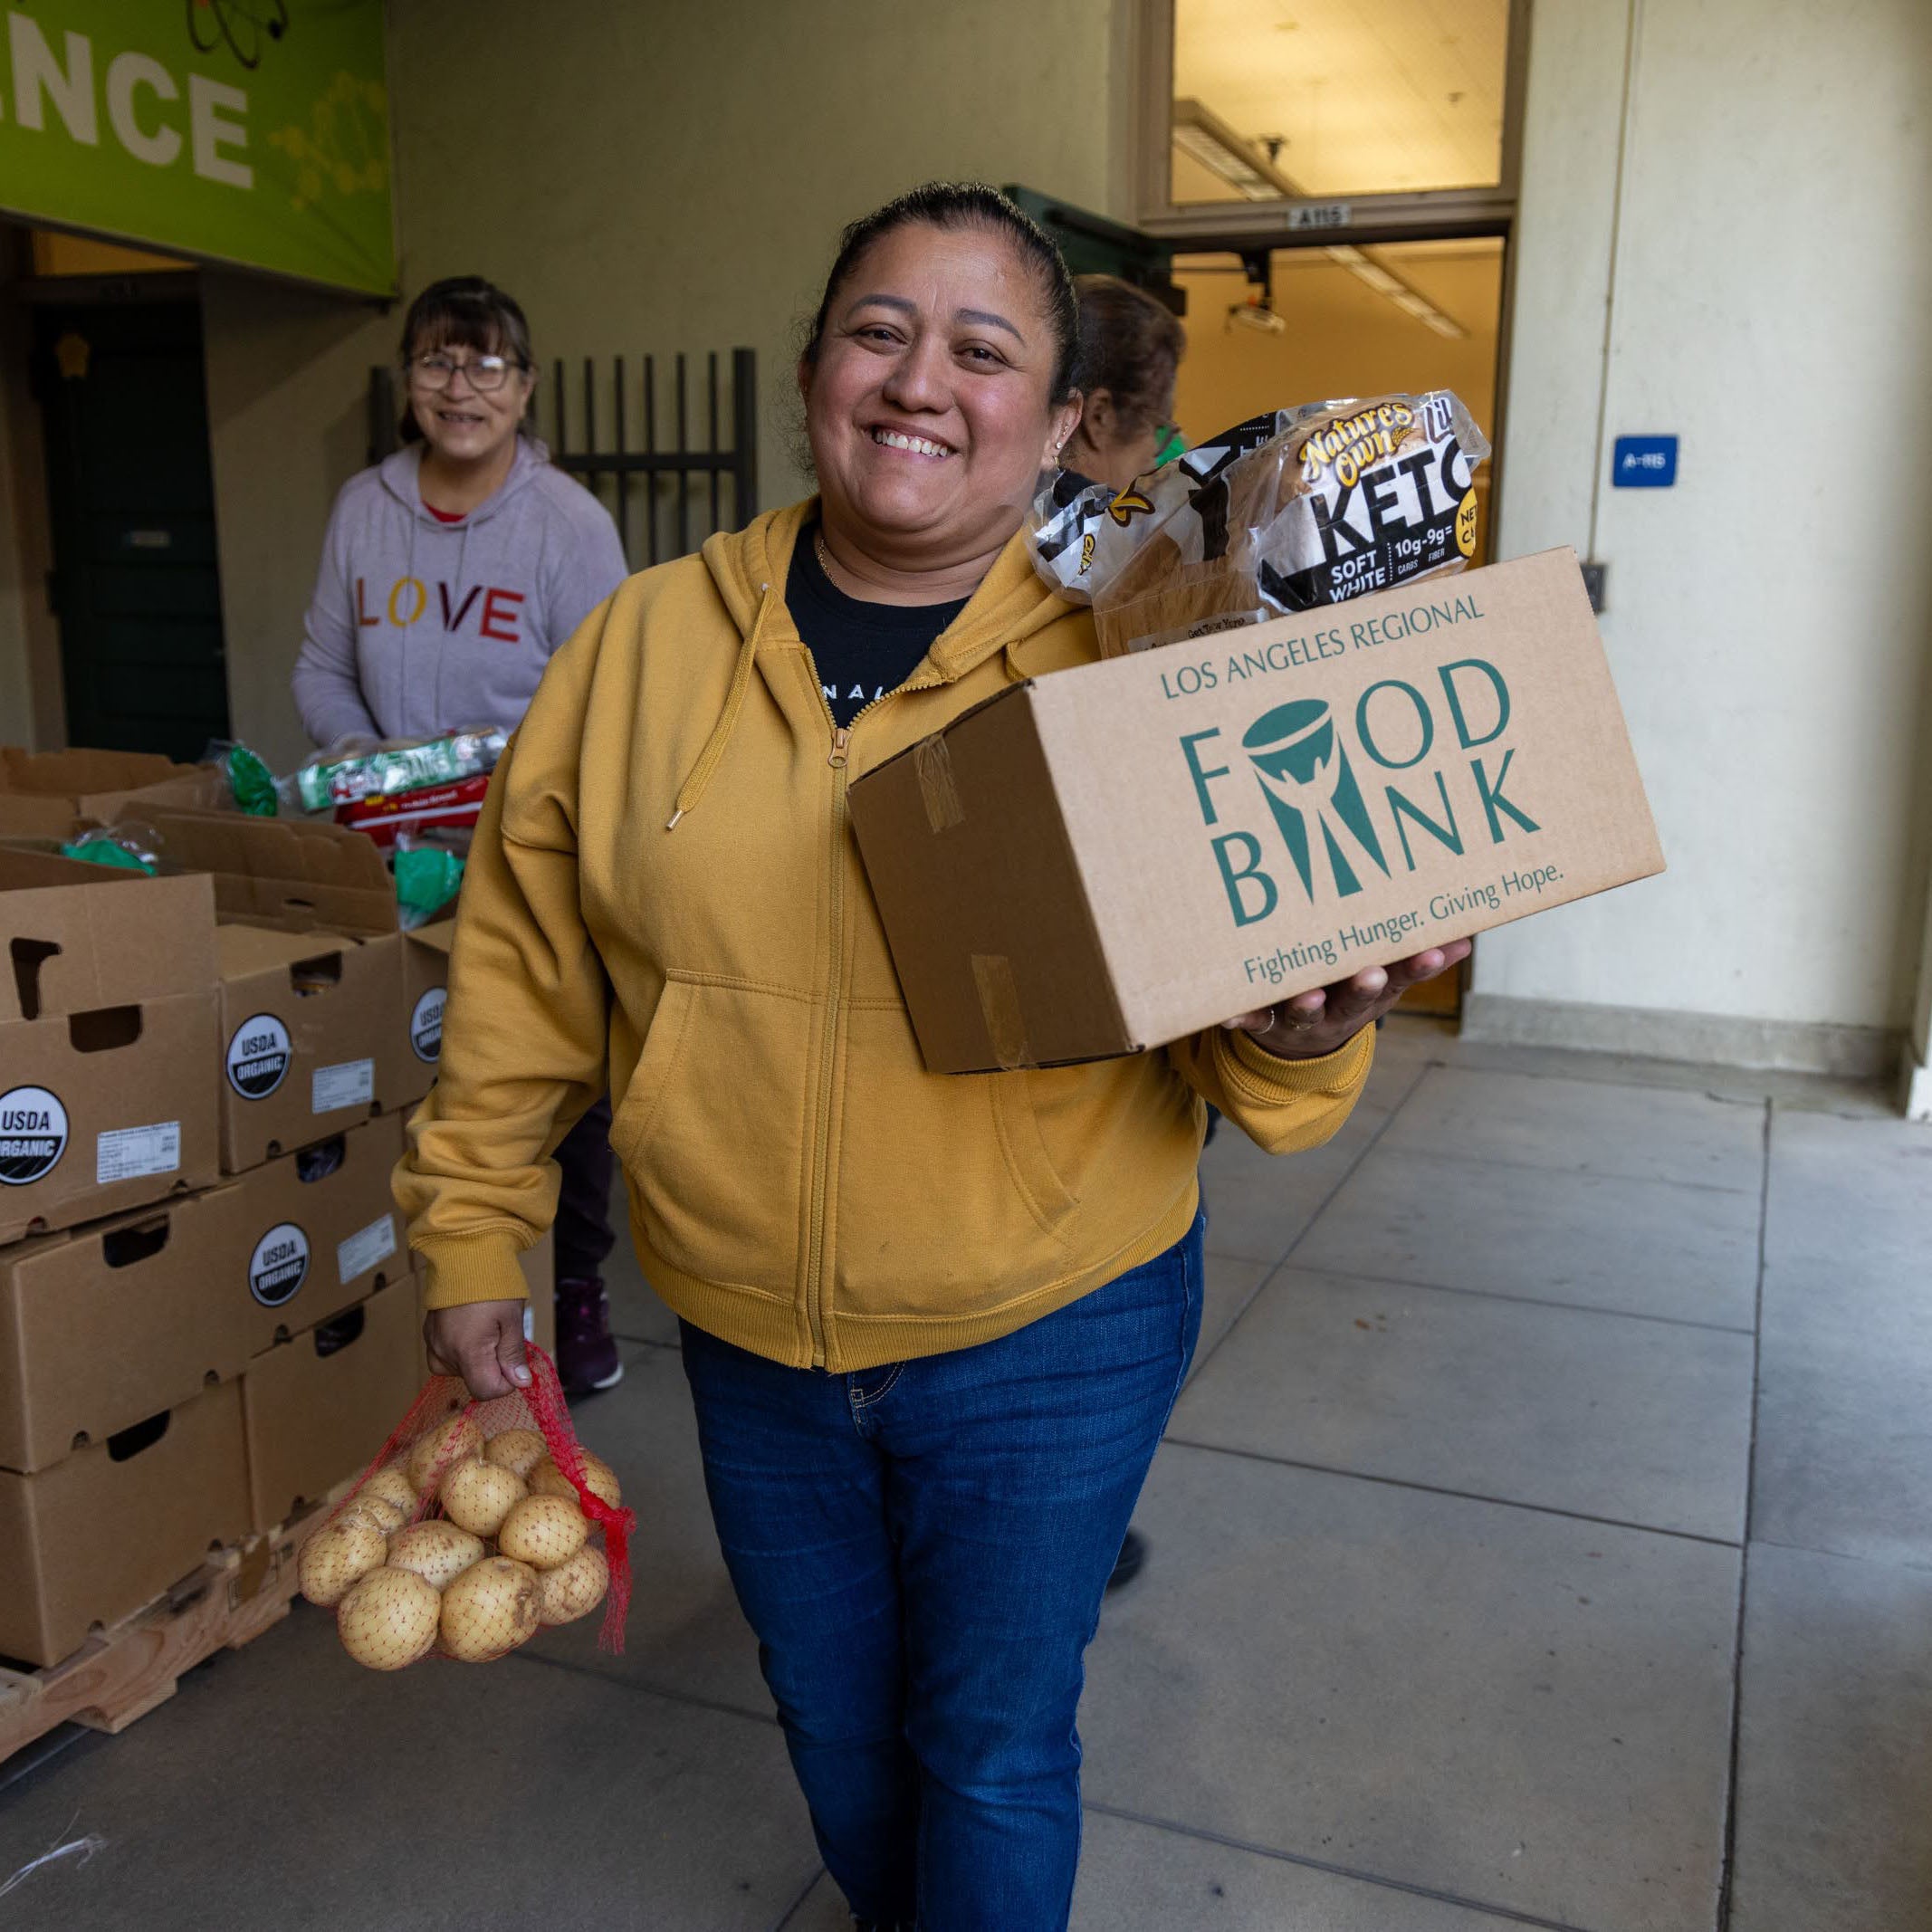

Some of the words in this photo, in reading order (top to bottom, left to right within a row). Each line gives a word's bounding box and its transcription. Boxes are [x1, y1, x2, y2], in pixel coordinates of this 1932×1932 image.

[0, 9, 254, 190] NCE
[1297, 402, 1413, 481] Nature's
[1334, 427, 1398, 488] Own
[1330, 550, 1377, 585] SOFT
[1397, 560, 1419, 575] CARBS
[1428, 548, 1446, 562] FIBER
[1328, 567, 1386, 603] WHITE
[357, 576, 525, 643] LOVE
[1160, 661, 1218, 700] LOS
[1227, 628, 1346, 683] ANGELES
[1350, 594, 1486, 650] REGIONAL
[1243, 938, 1338, 985] Fighting
[1339, 908, 1425, 952] Hunger.
[1429, 881, 1500, 921] Giving
[1501, 863, 1564, 896] Hope.
[241, 1032, 277, 1057] USDA
[236, 1056, 284, 1082] ORGANIC
[3, 1111, 51, 1131] USDA
[0, 1140, 55, 1157] RGANIC
[262, 1239, 297, 1267] USDA
[258, 1259, 304, 1290] ORGANIC
